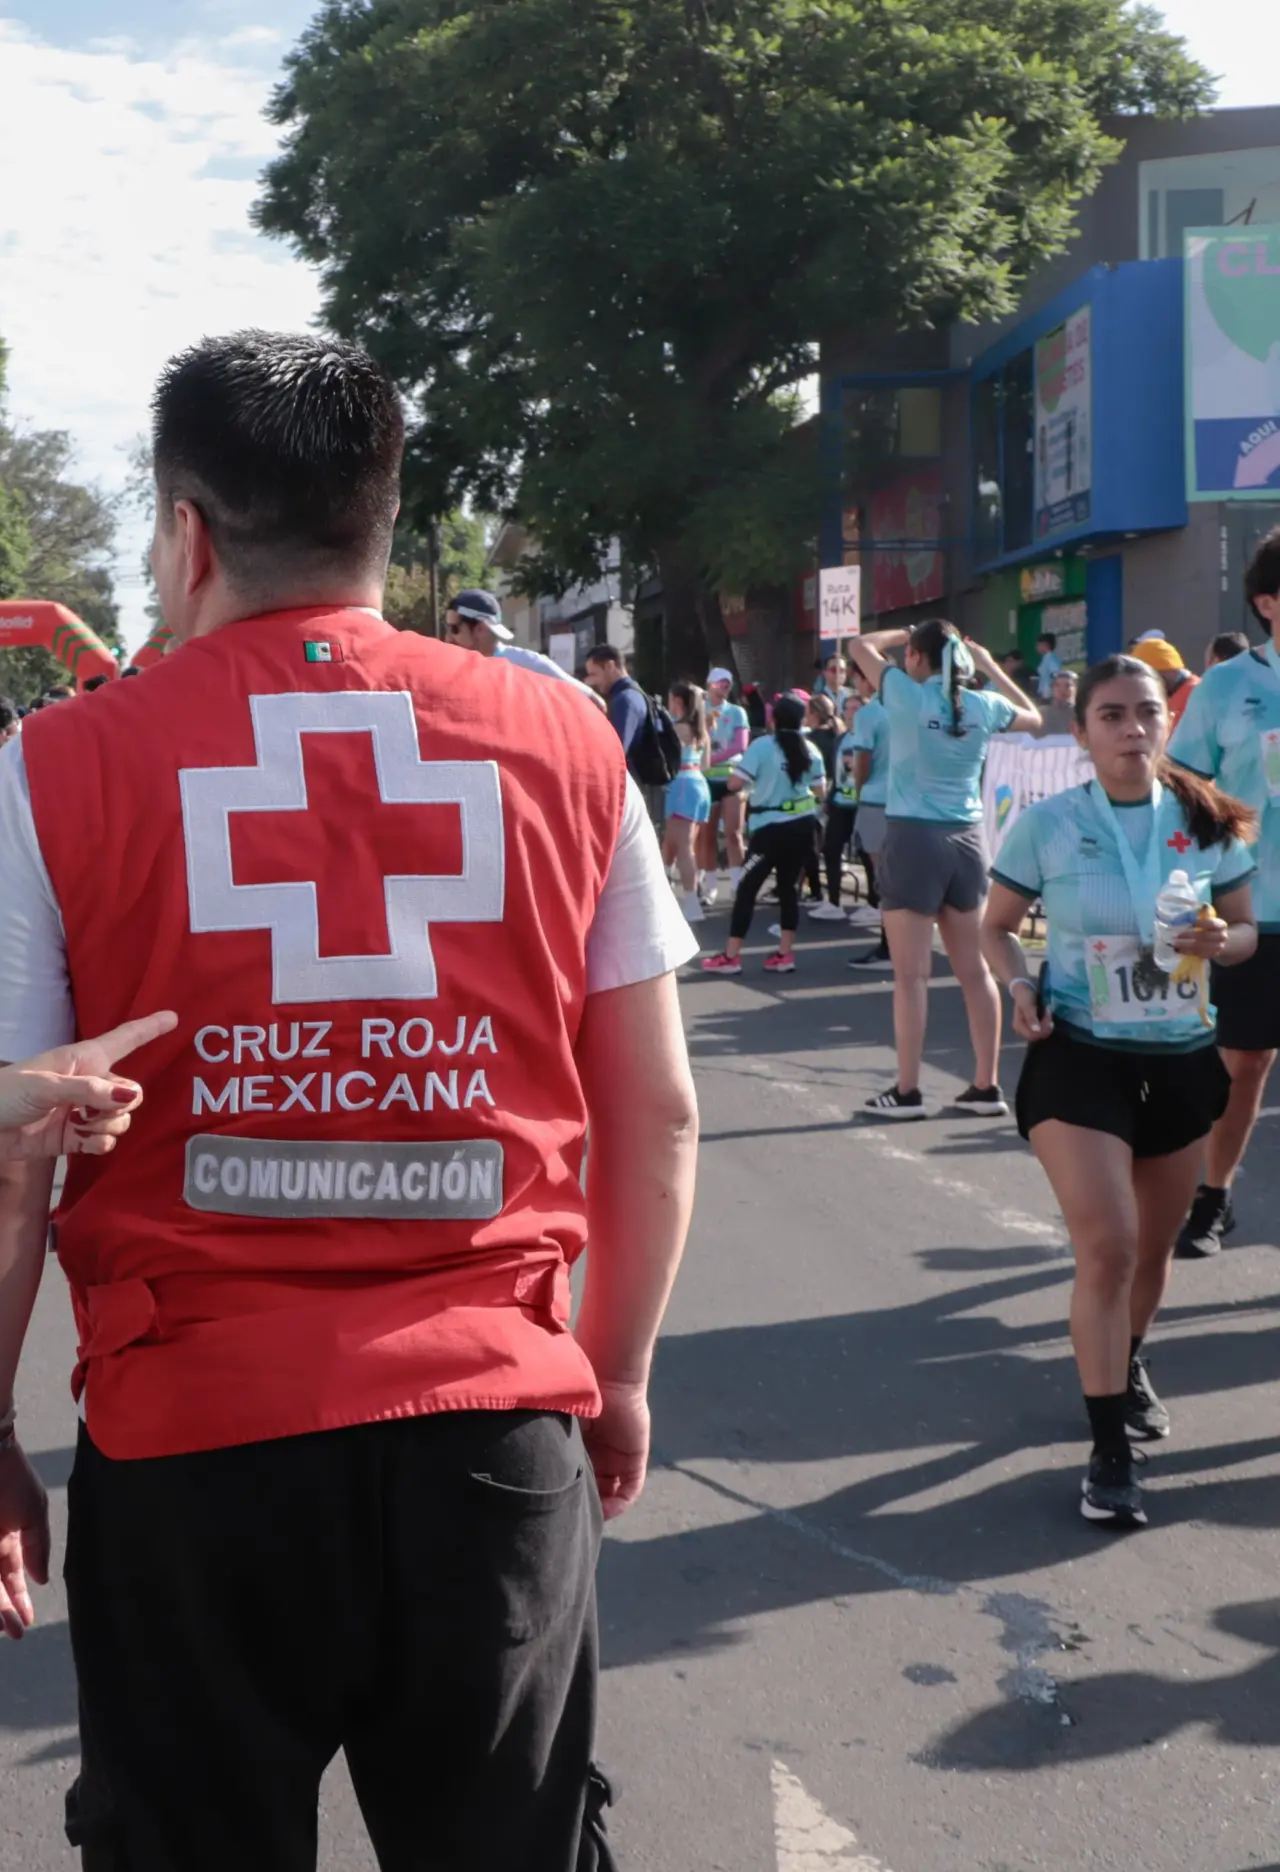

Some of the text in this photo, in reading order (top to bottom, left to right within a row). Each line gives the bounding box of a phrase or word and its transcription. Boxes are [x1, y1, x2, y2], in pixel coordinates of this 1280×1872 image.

[1239, 420, 1278, 454] AQUI
[823, 594, 856, 617] 14K
[194, 1015, 498, 1064] CRUZ ROJA
[191, 1069, 496, 1115] MEXICANA
[193, 1150, 494, 1201] COMUNICACIÓN
